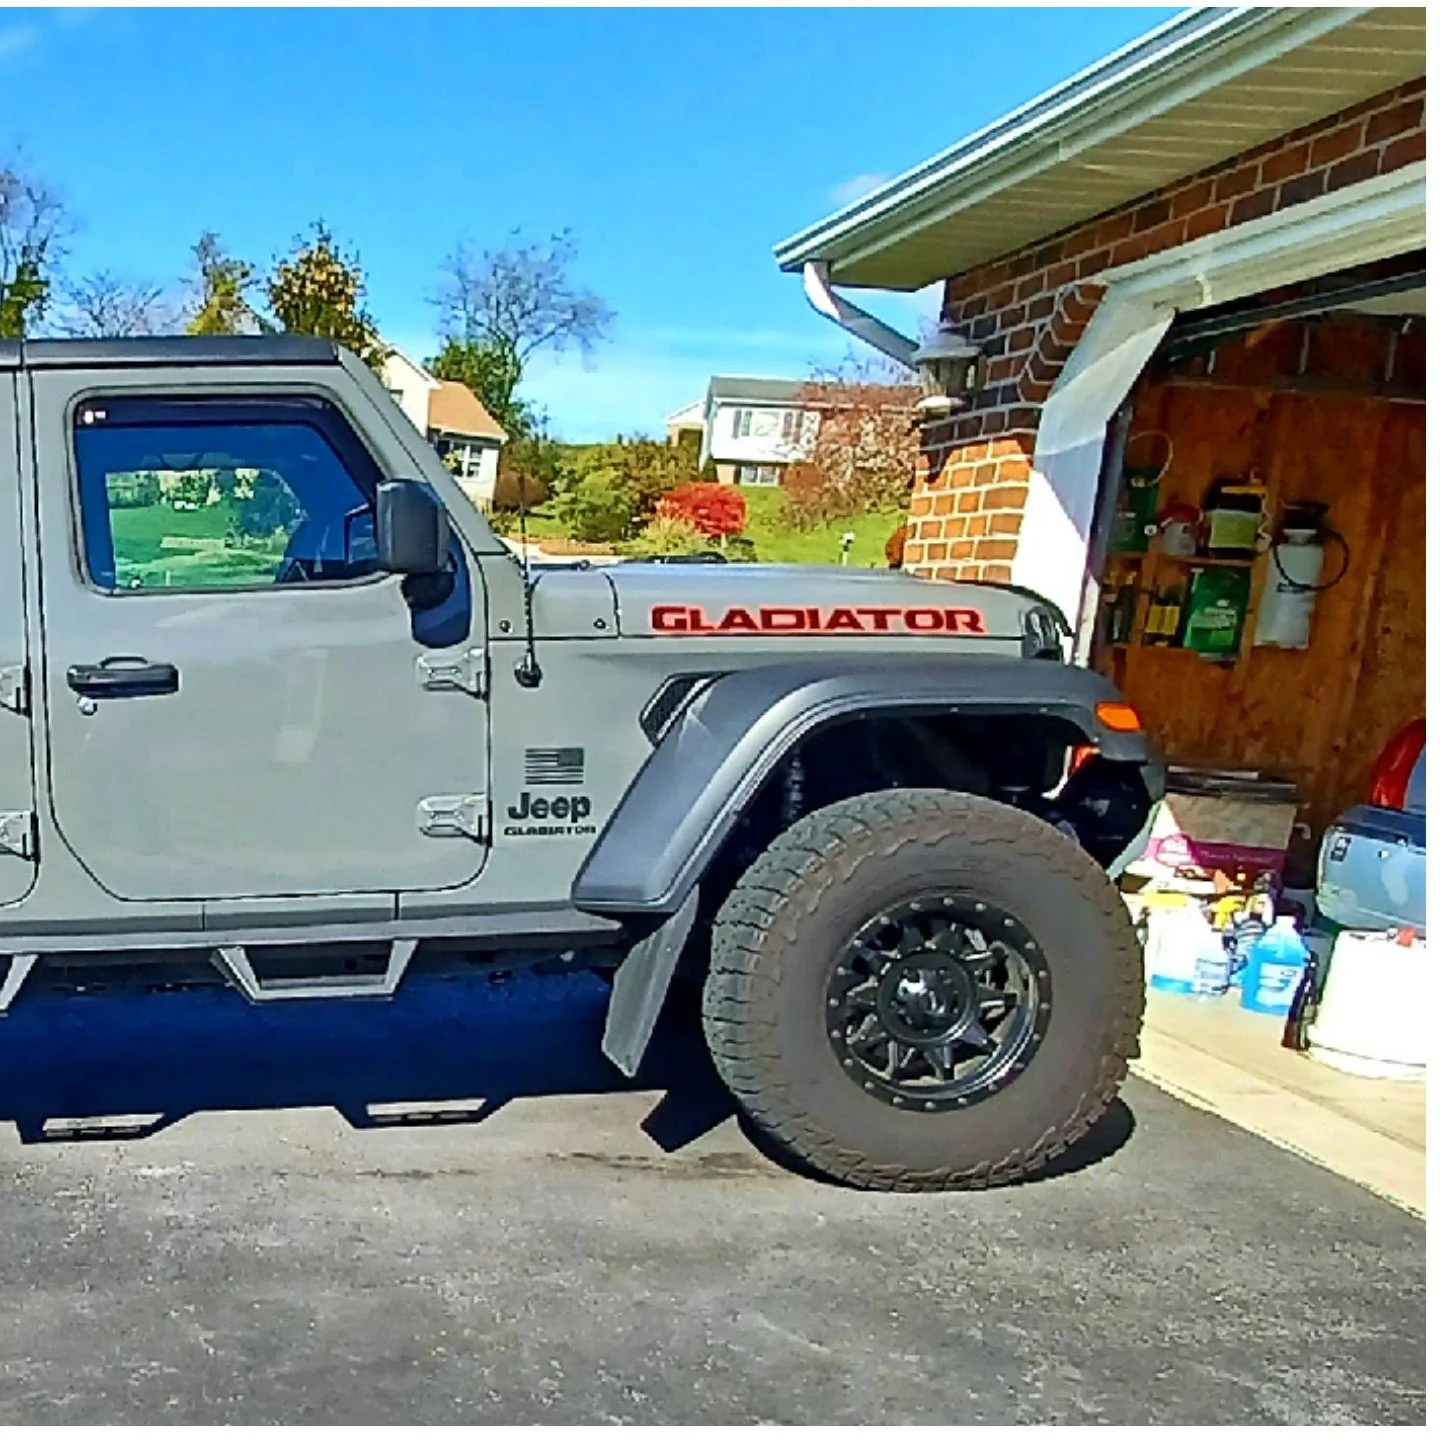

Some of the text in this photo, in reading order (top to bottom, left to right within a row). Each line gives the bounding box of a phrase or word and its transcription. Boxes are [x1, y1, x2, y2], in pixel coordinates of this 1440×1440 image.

[650, 605, 986, 634] GLADIATOR
[507, 791, 591, 823] Jeep
[503, 825, 597, 836] GLADIATOR
